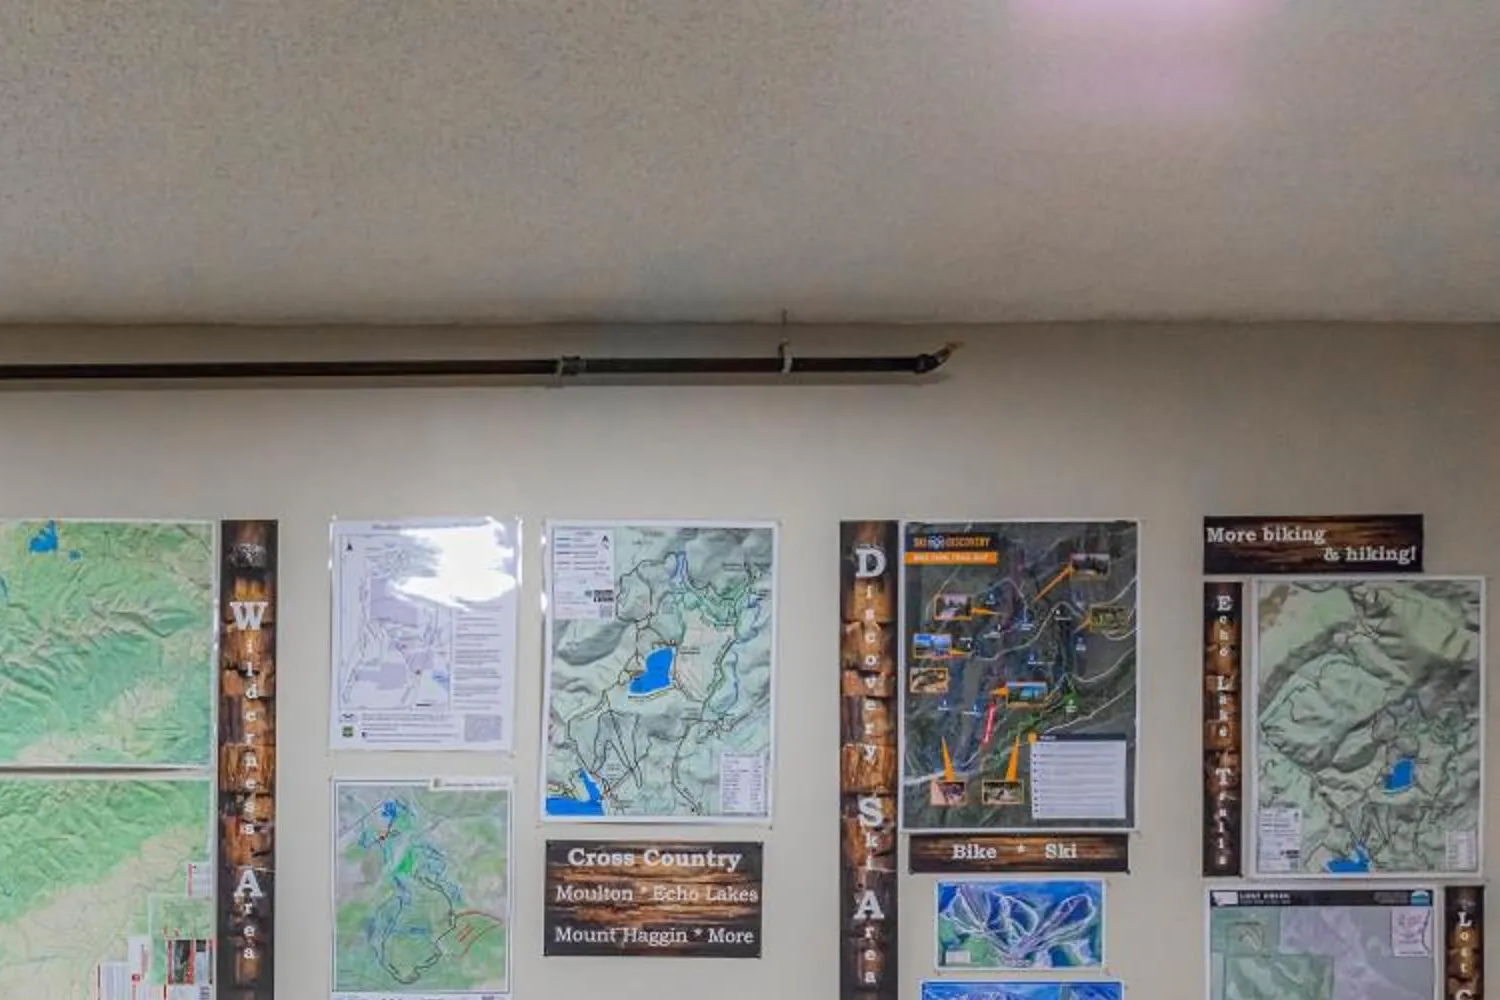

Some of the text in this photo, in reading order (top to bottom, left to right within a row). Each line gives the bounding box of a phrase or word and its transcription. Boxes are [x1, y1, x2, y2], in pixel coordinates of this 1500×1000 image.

[1206, 526, 1327, 544] More biking
[1323, 546, 1416, 564] & hiking!
[853, 549, 886, 983] Discovery Ski Area
[229, 601, 269, 960] Wilderness Area
[567, 848, 742, 872] Cross Country
[952, 843, 1078, 859] Bike Ski
[555, 884, 759, 902] Moulton Echo Lakes
[555, 927, 754, 946] Mount Haggin More
